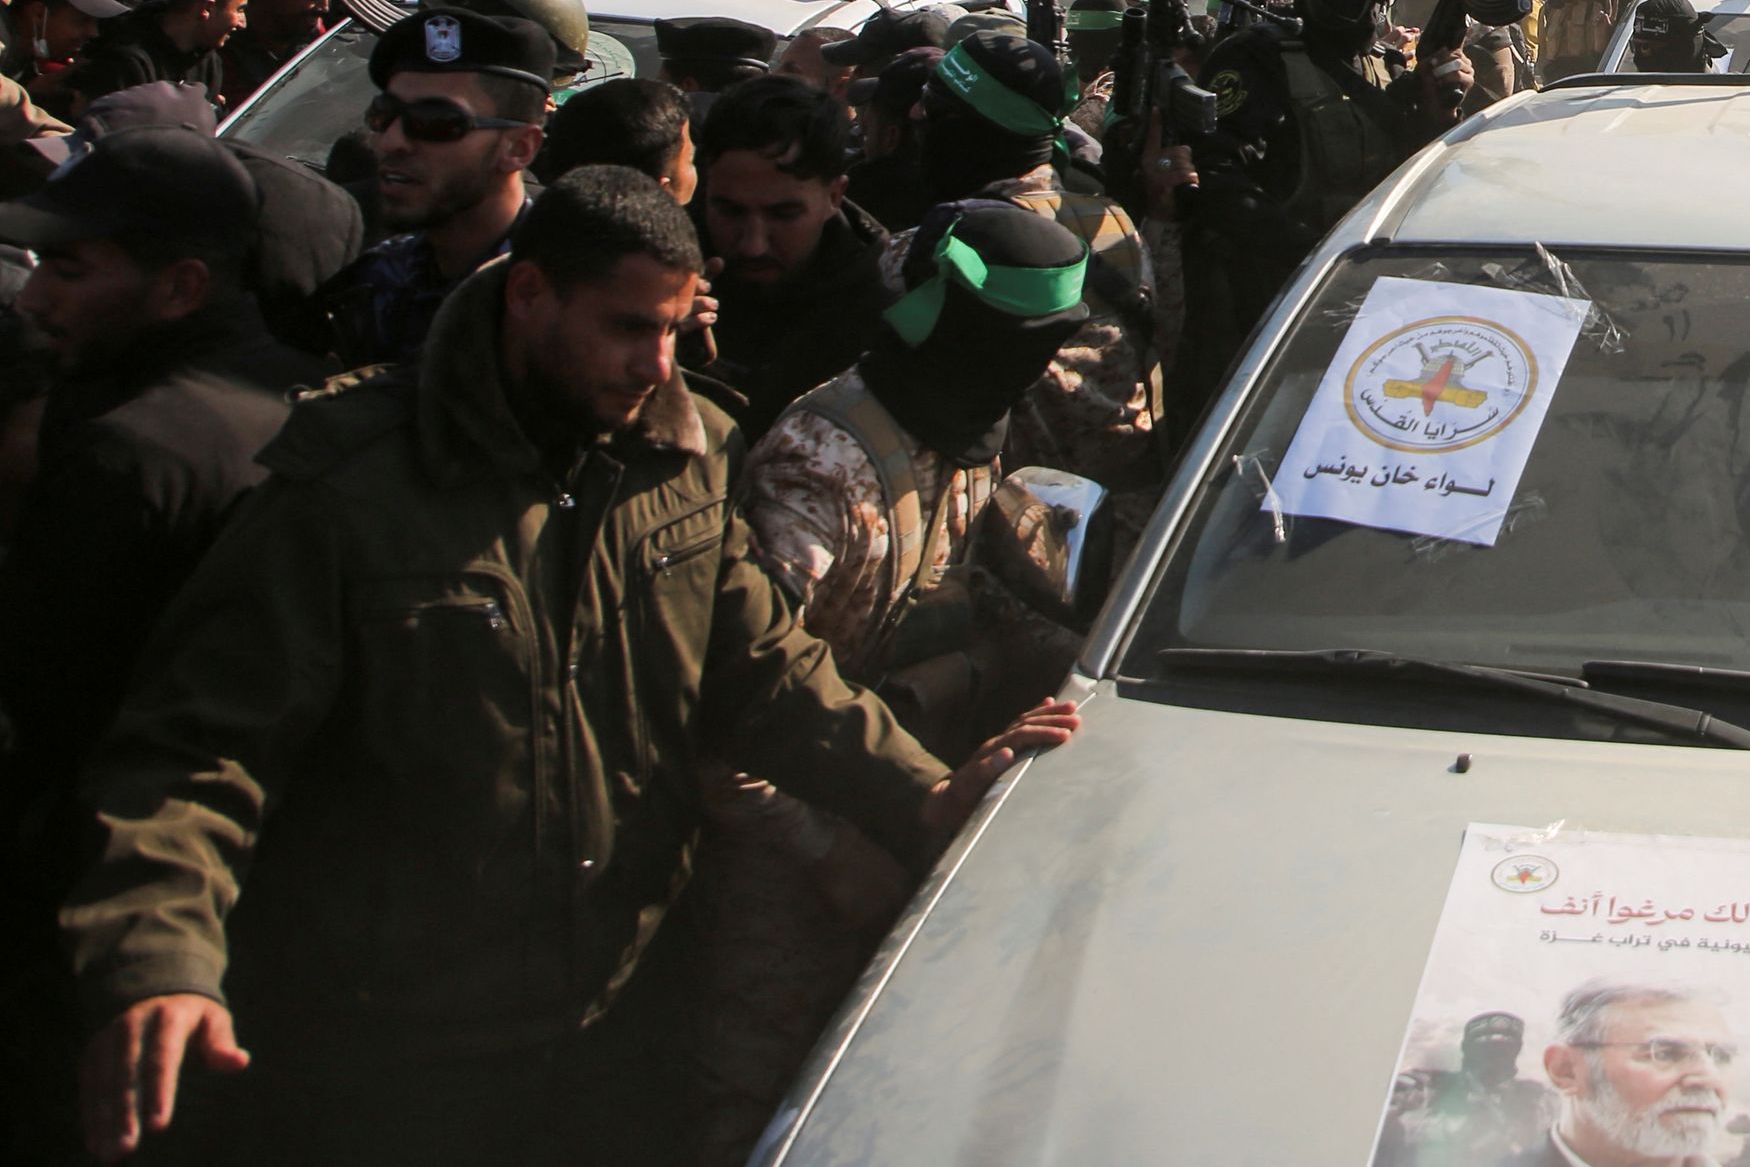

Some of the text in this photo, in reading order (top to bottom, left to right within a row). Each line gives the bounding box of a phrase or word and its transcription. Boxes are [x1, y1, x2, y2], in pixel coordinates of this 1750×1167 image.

[1360, 389, 1499, 440] سرايا القدس
[1303, 455, 1496, 497] لواء خان يونس
[1540, 891, 1602, 915] أنف
[1607, 896, 1695, 925] مرغوا
[1540, 930, 1603, 945] غزة
[1609, 934, 1650, 946] تراب
[1657, 937, 1691, 952] في
